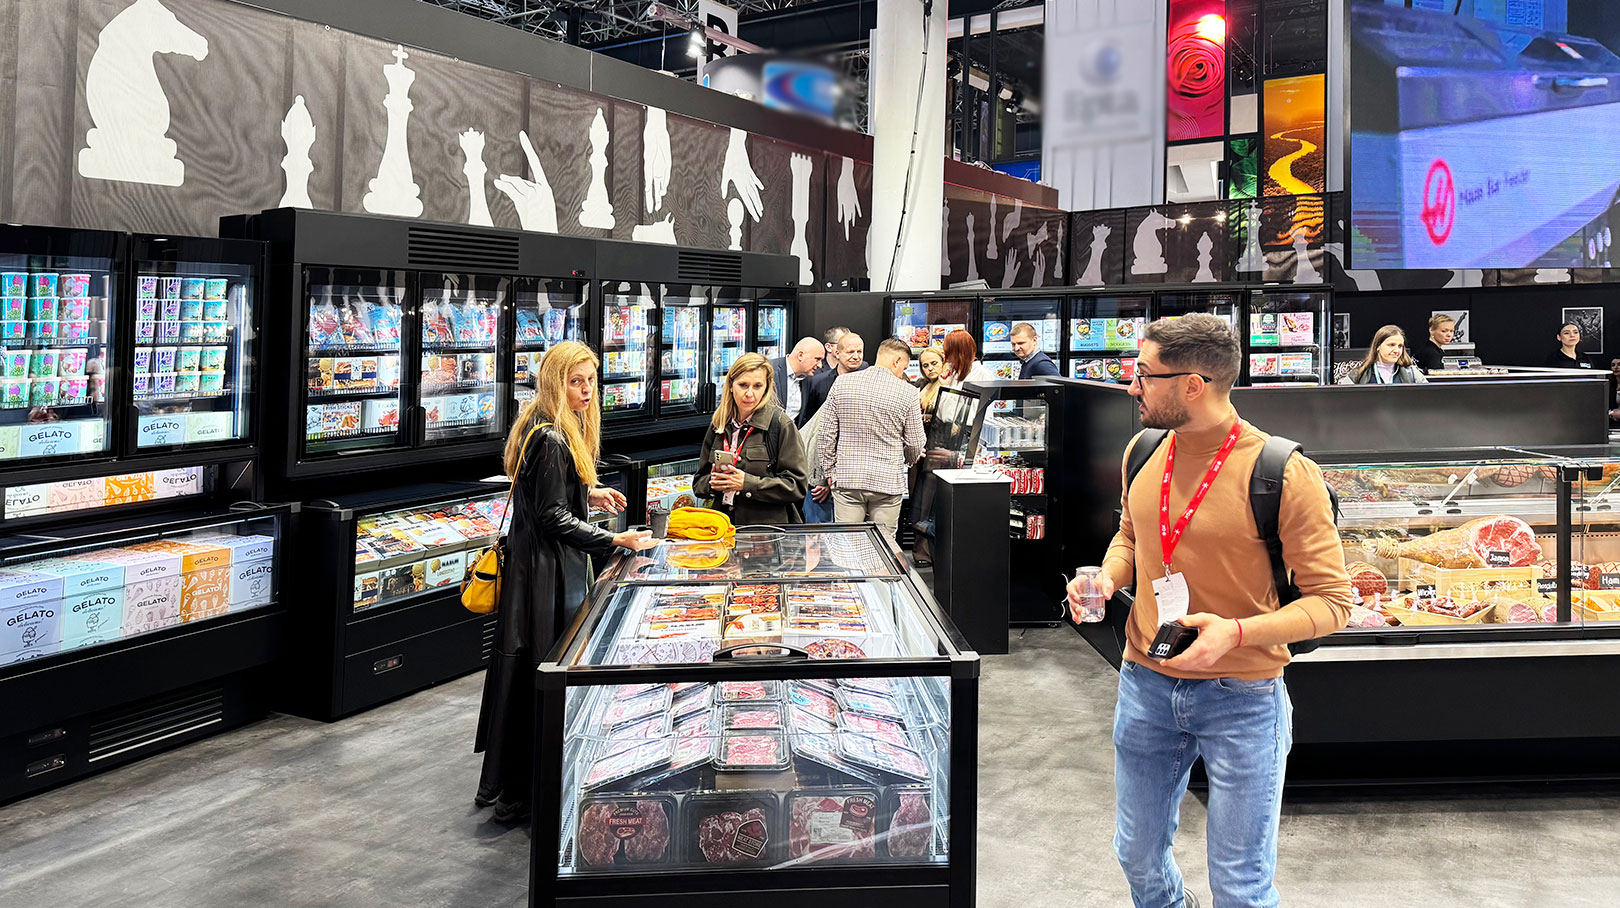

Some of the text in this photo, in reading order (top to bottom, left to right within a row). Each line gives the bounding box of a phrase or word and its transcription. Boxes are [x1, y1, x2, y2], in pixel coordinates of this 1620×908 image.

[142, 422, 180, 433] GELATO
[28, 430, 72, 442] GELATO
[245, 546, 268, 557] GELATO
[194, 555, 218, 566] GELATO
[140, 566, 166, 576] GELATO
[239, 565, 273, 580] GELATO
[80, 576, 109, 587] GELATO
[15, 587, 48, 599] GELATO
[192, 585, 220, 596] GELATO
[72, 597, 116, 613] GELATO
[137, 596, 168, 608] GELATO
[6, 610, 55, 627] GELATO
[628, 817, 643, 825] MEAT
